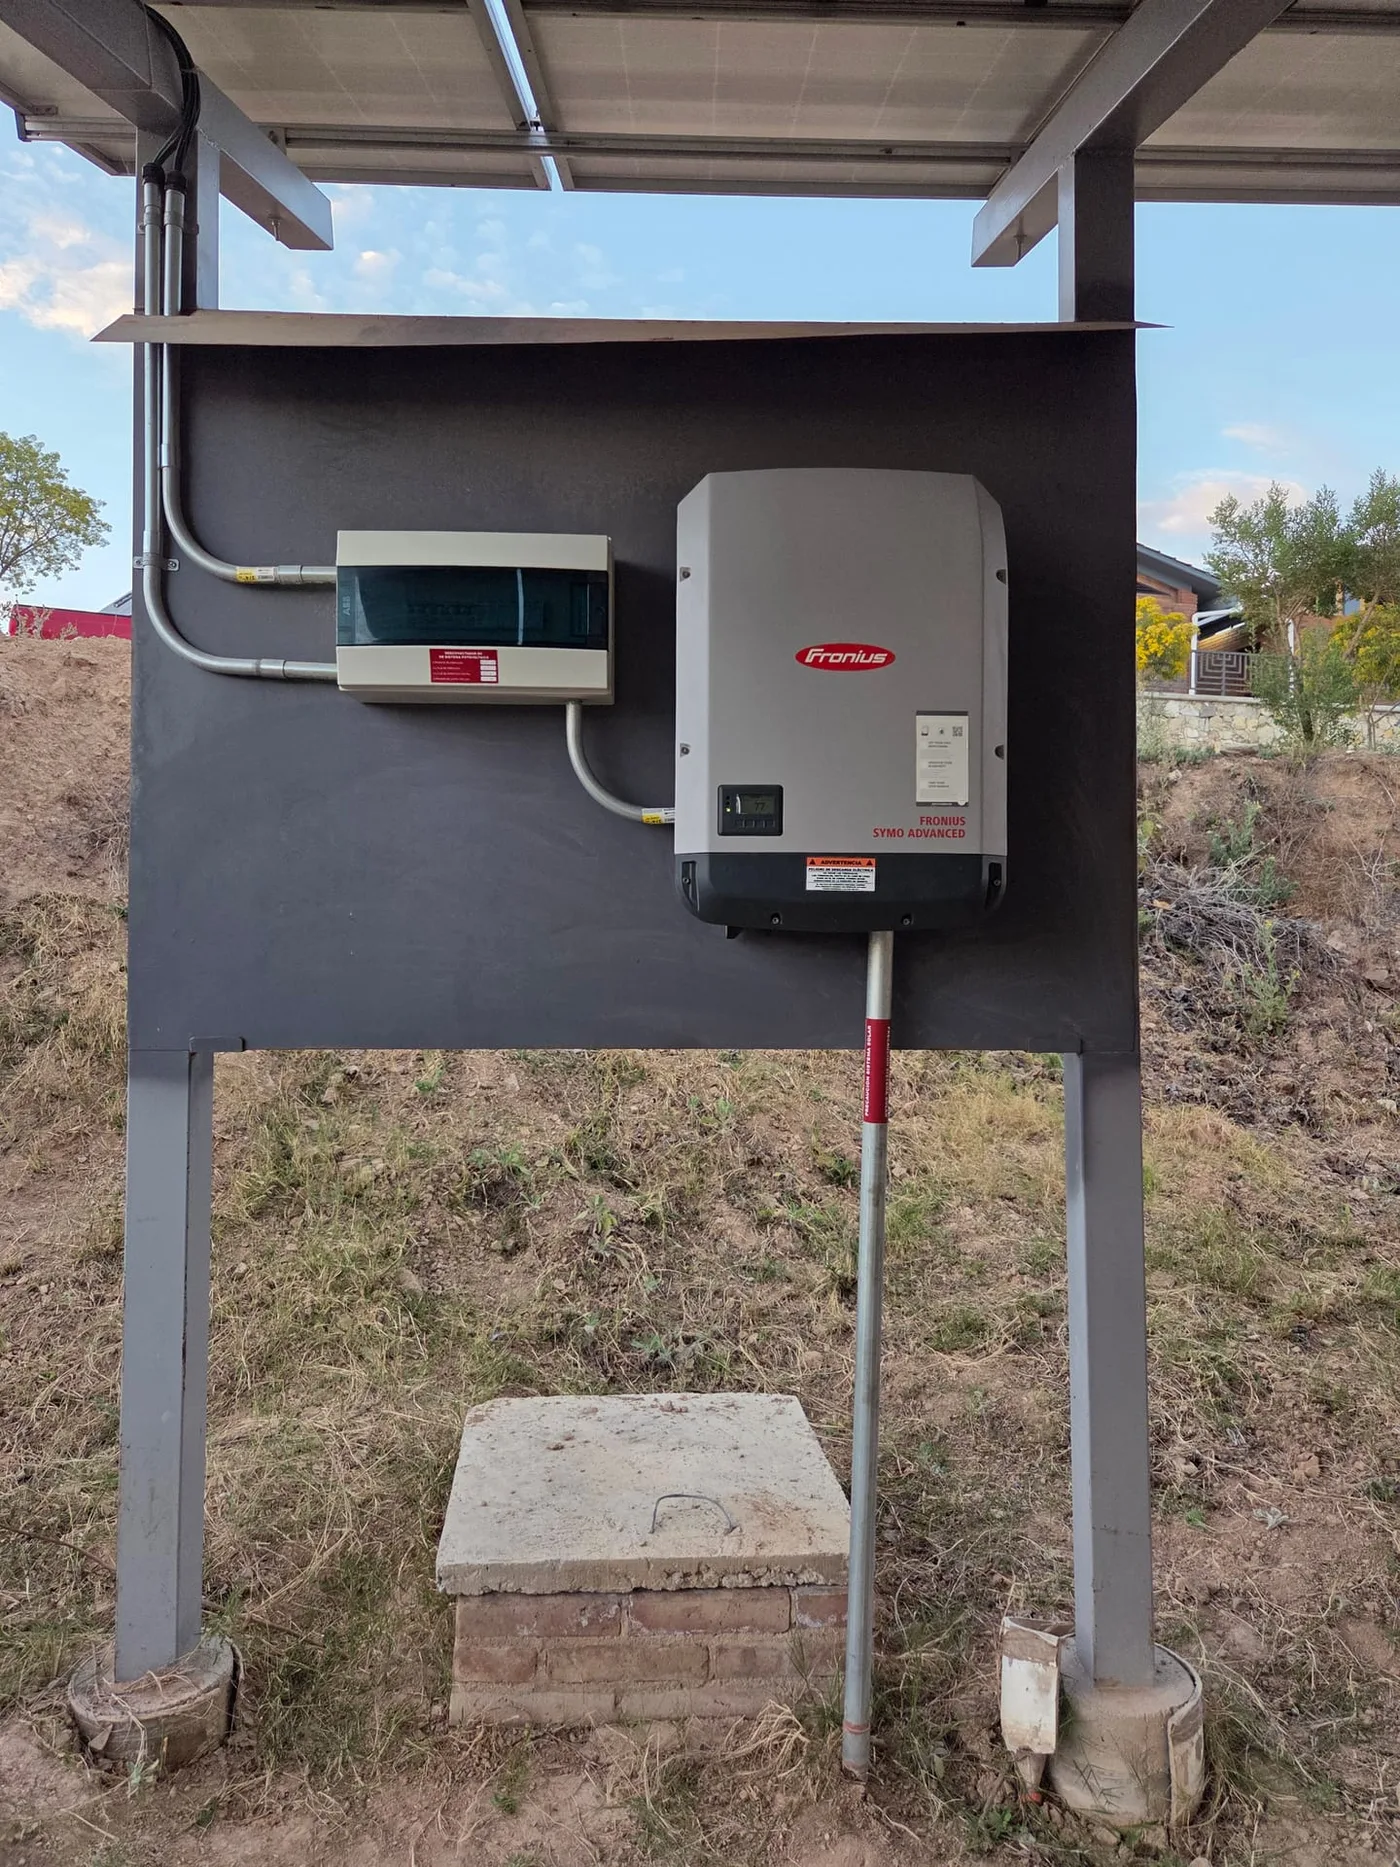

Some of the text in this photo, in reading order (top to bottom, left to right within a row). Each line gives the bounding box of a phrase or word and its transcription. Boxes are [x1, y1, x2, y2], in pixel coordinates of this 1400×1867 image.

[342, 596, 350, 616] ABB
[805, 648, 887, 663] Fronius
[919, 816, 966, 826] FRONIUS
[873, 828, 966, 838] SYMO ADVANCED
